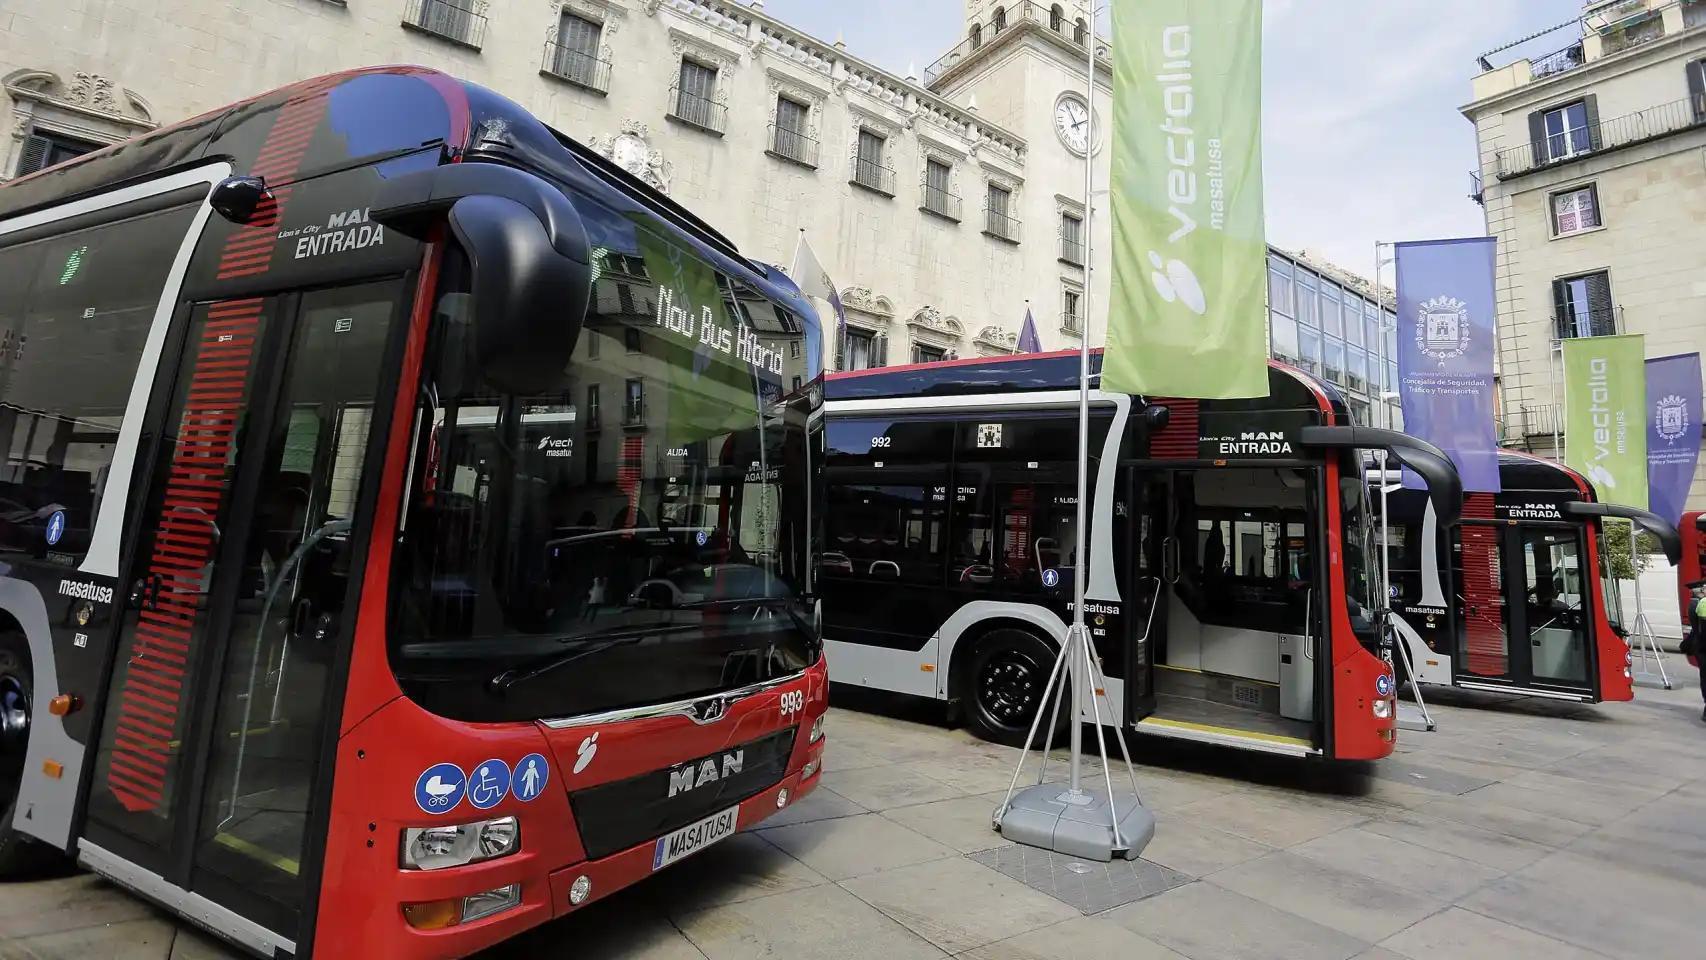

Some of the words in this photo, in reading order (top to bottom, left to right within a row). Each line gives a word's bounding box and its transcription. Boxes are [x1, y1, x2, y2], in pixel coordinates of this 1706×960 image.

[1156, 25, 1197, 243] vectalia
[1207, 138, 1223, 230] masatusa
[294, 223, 384, 259] ENTRADA
[303, 225, 321, 234] City
[656, 284, 695, 338] Nou
[699, 305, 733, 354] Bus
[1587, 357, 1609, 460] vectalia
[871, 436, 891, 448] 992
[1219, 442, 1292, 454] ENTRADA
[1241, 431, 1284, 441] MAN
[1509, 509, 1562, 519] ENTRADA
[58, 579, 114, 604] masatusa
[1066, 602, 1120, 614] msatusa
[1405, 606, 1446, 615] masatusa
[780, 689, 803, 716] 993
[668, 749, 744, 798] MAN
[668, 811, 733, 860] MASATUSA
